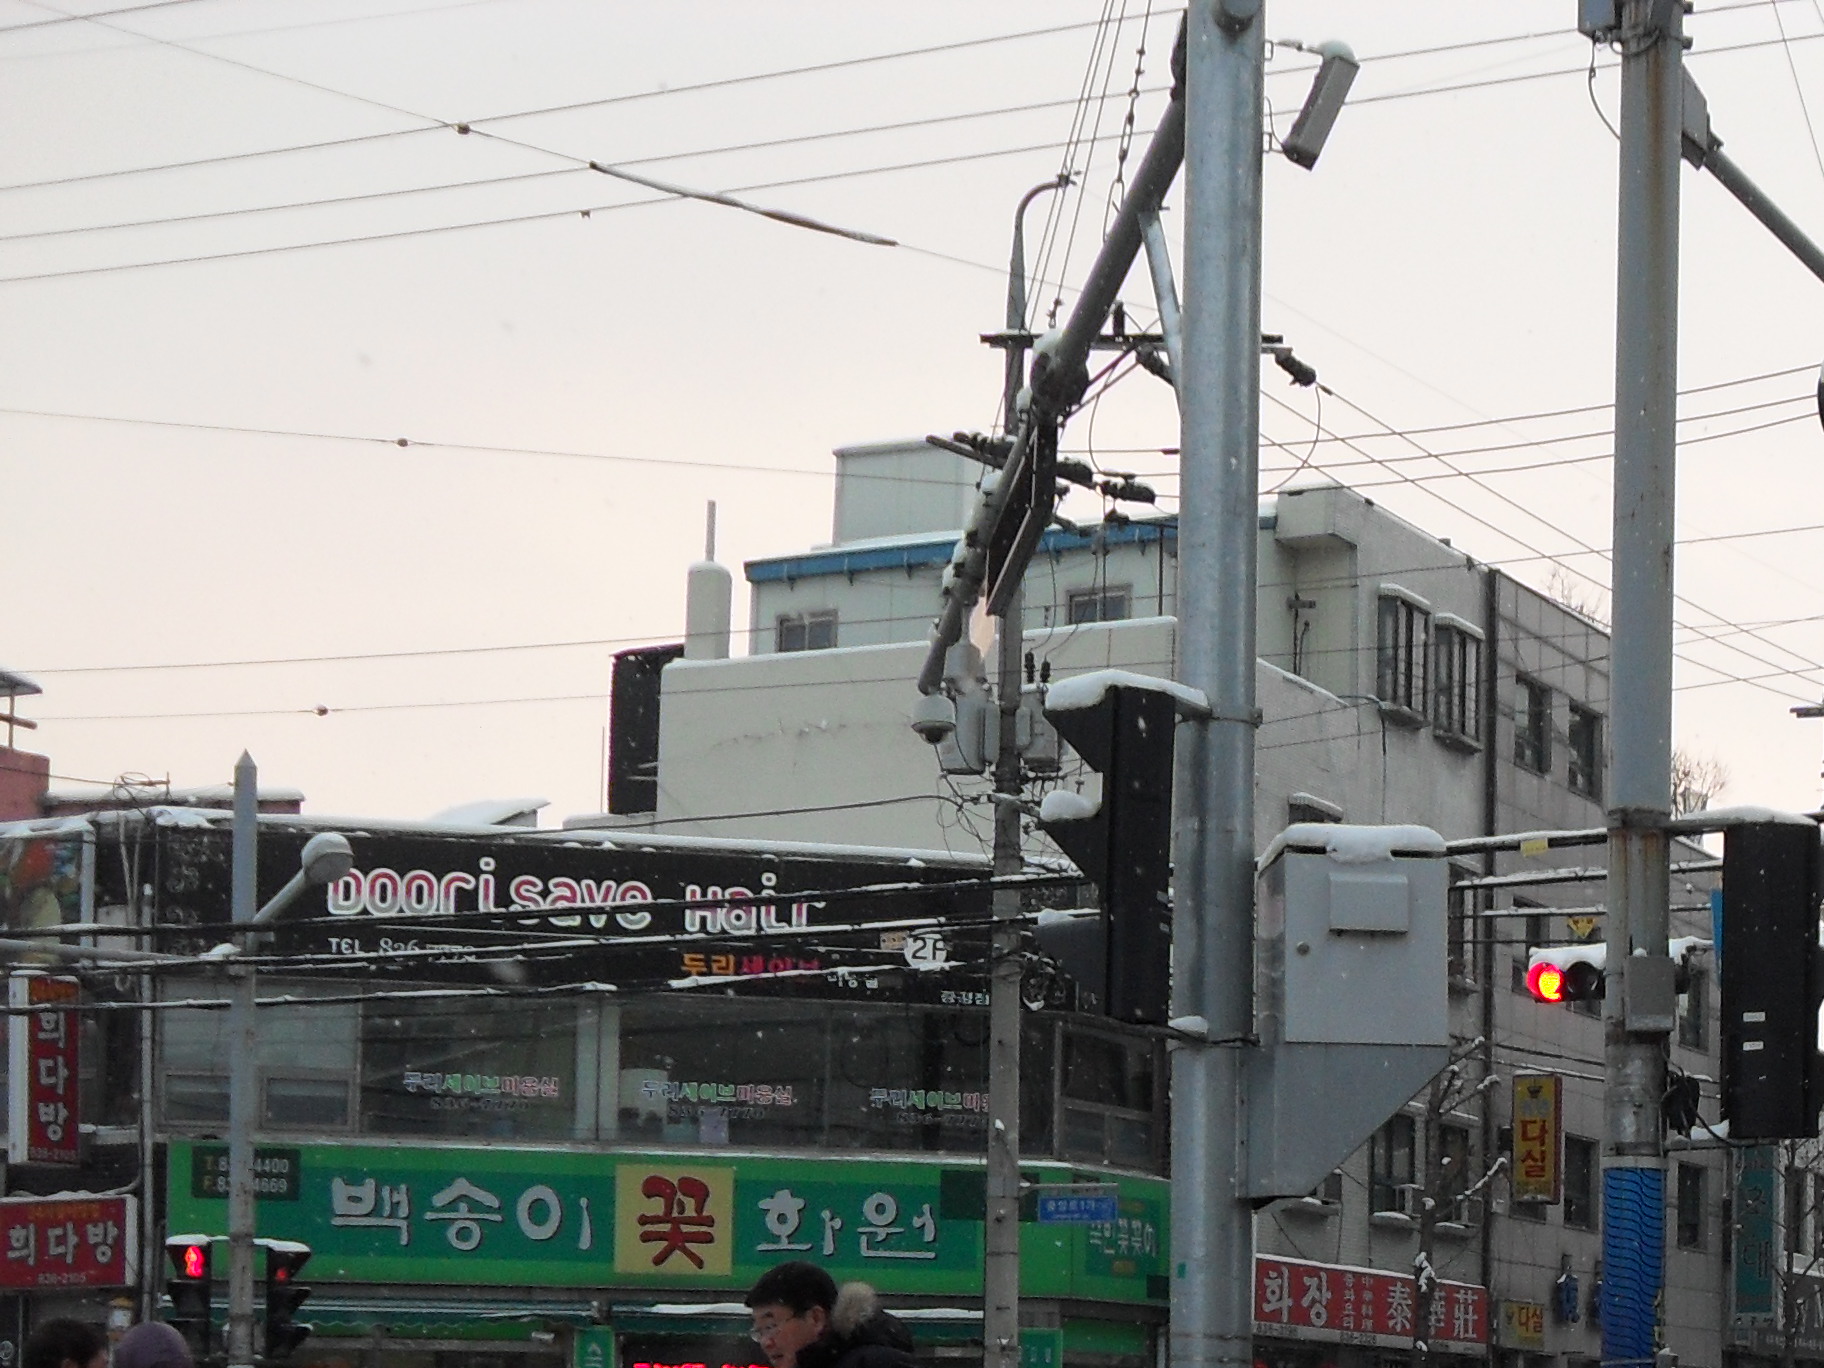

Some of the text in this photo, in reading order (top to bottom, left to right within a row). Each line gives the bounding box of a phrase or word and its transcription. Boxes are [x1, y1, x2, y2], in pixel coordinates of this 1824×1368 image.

[1519, 1118, 1550, 1179] 다실
[7, 1221, 118, 1264] 희다방
[331, 1174, 937, 1270] 백송이 꽃 화원
[1518, 1305, 1544, 1334] 다실
